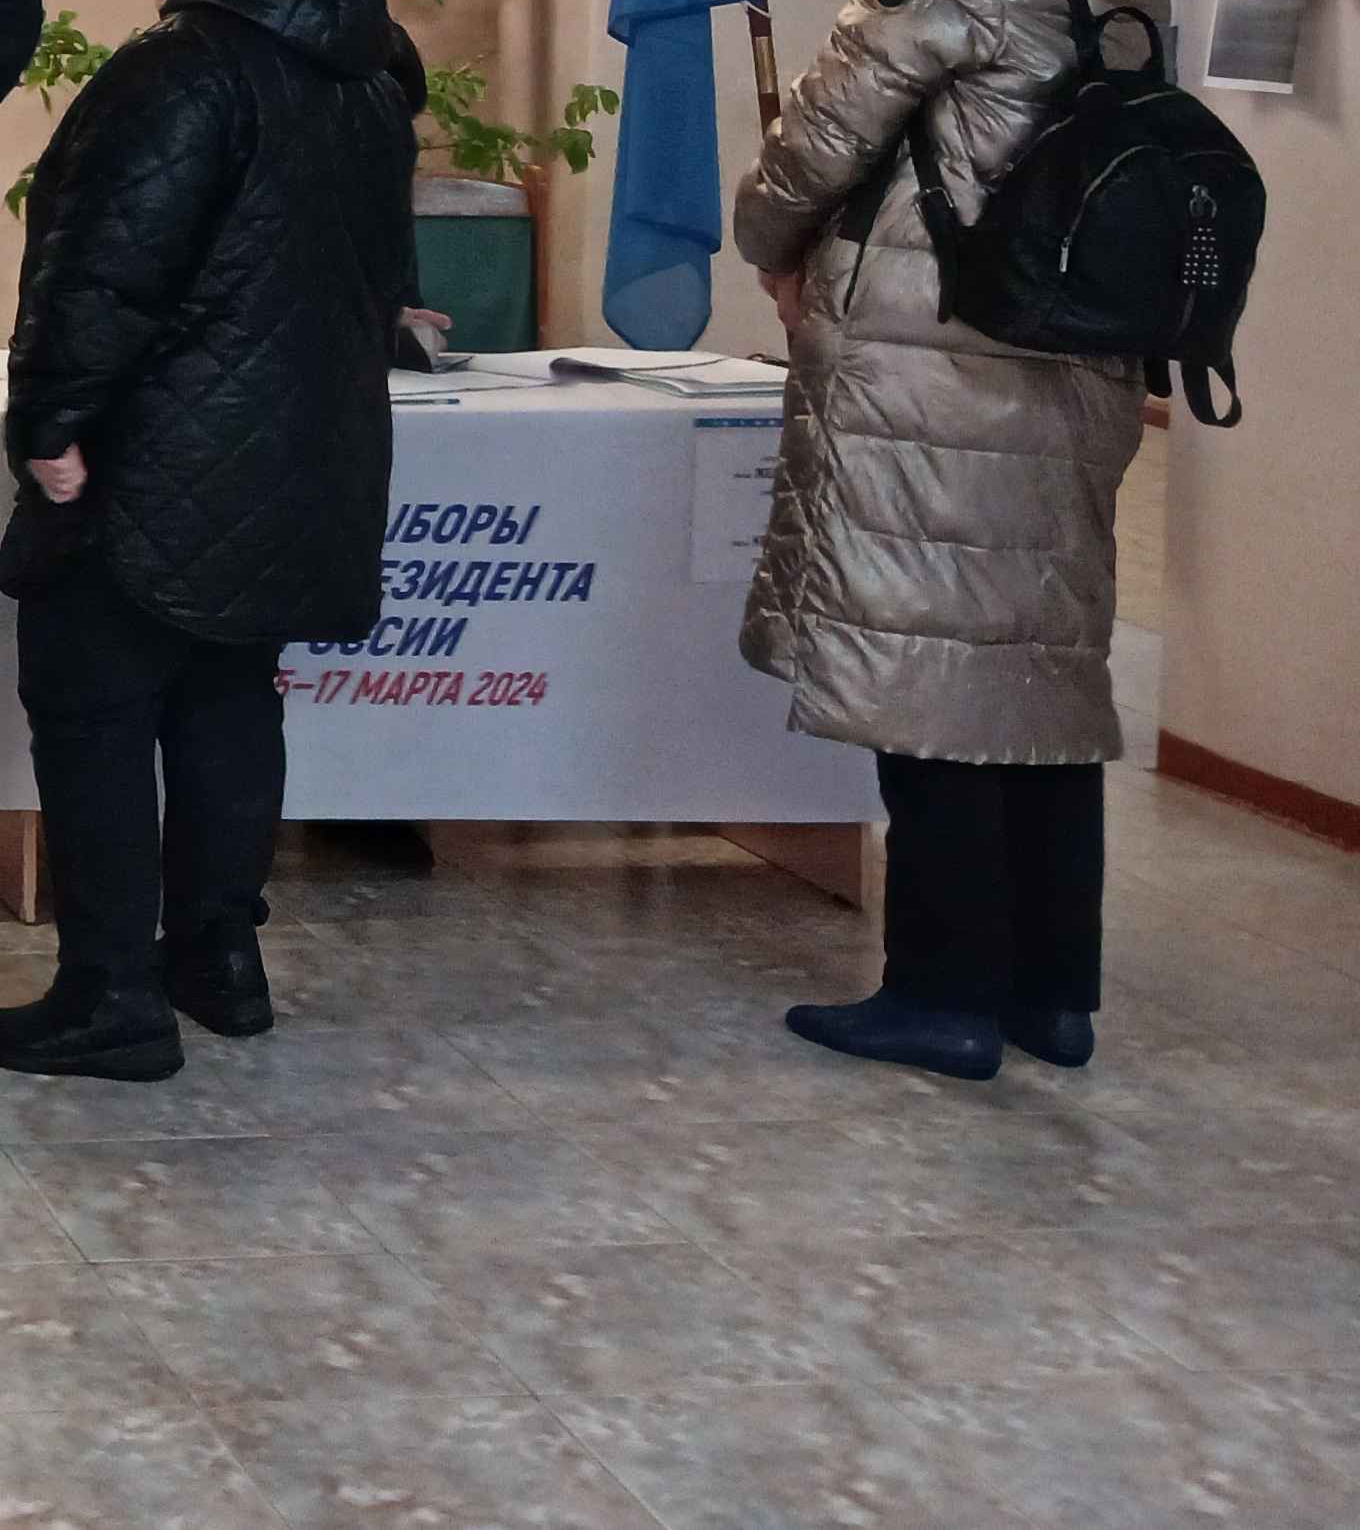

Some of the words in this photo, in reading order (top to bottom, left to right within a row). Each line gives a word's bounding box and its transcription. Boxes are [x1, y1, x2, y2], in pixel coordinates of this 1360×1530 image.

[380, 559, 597, 607] ЕЗИДЕНТА
[350, 670, 465, 706] МАРТА
[467, 671, 549, 707] 2024
